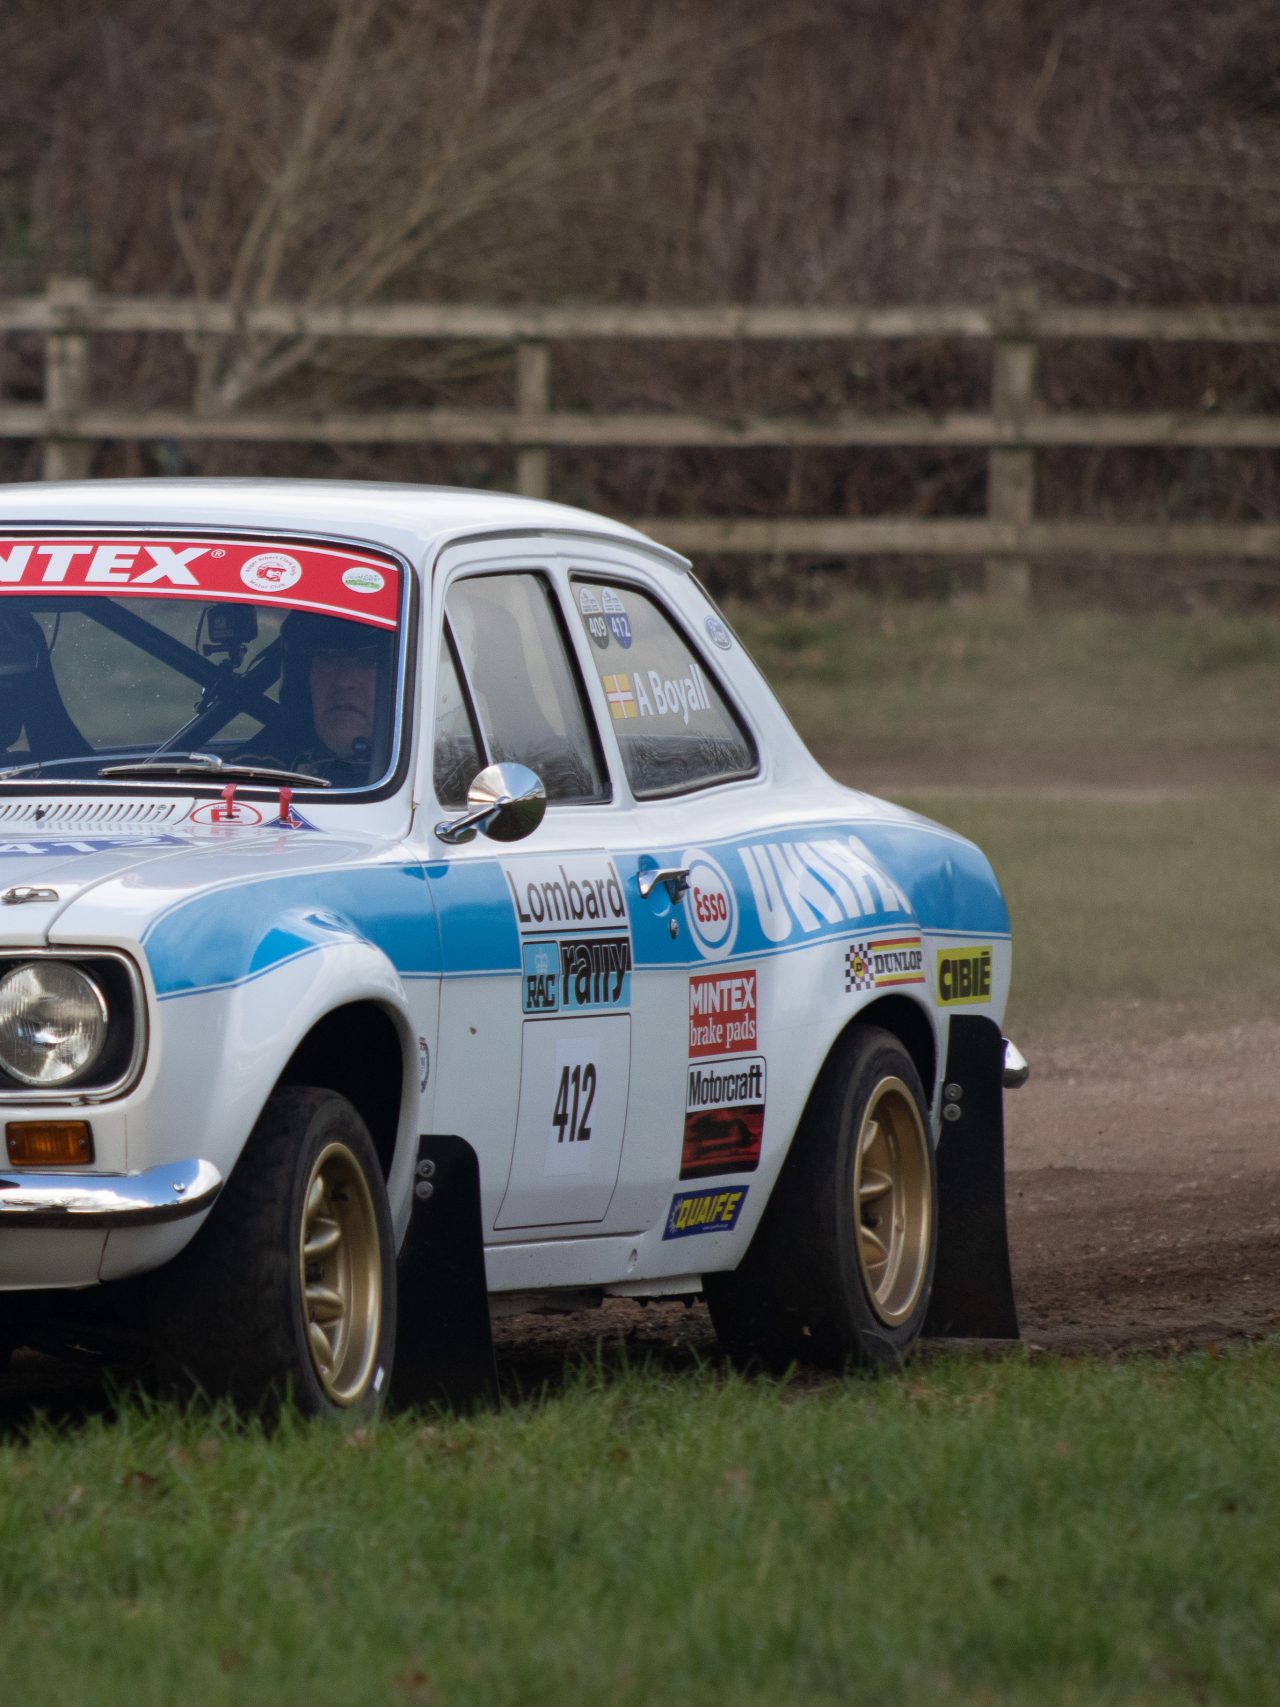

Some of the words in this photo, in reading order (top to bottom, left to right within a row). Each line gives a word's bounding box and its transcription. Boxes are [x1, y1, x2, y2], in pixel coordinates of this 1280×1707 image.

[588, 616, 607, 638] 409
[611, 616, 631, 638] 412
[632, 672, 654, 717] A
[647, 663, 710, 726] Boyall
[506, 861, 626, 924] Lombard
[693, 886, 728, 923] Esso
[526, 974, 556, 1009] RAC
[561, 943, 629, 1006] rally
[873, 950, 923, 975] DUNLOP
[689, 976, 756, 1017] MINTEX
[690, 1016, 723, 1047] brake
[725, 1012, 756, 1049] pads
[552, 1062, 597, 1143] 412
[688, 1064, 763, 1107] Motorcraft
[675, 1191, 744, 1230] QUAIFE
